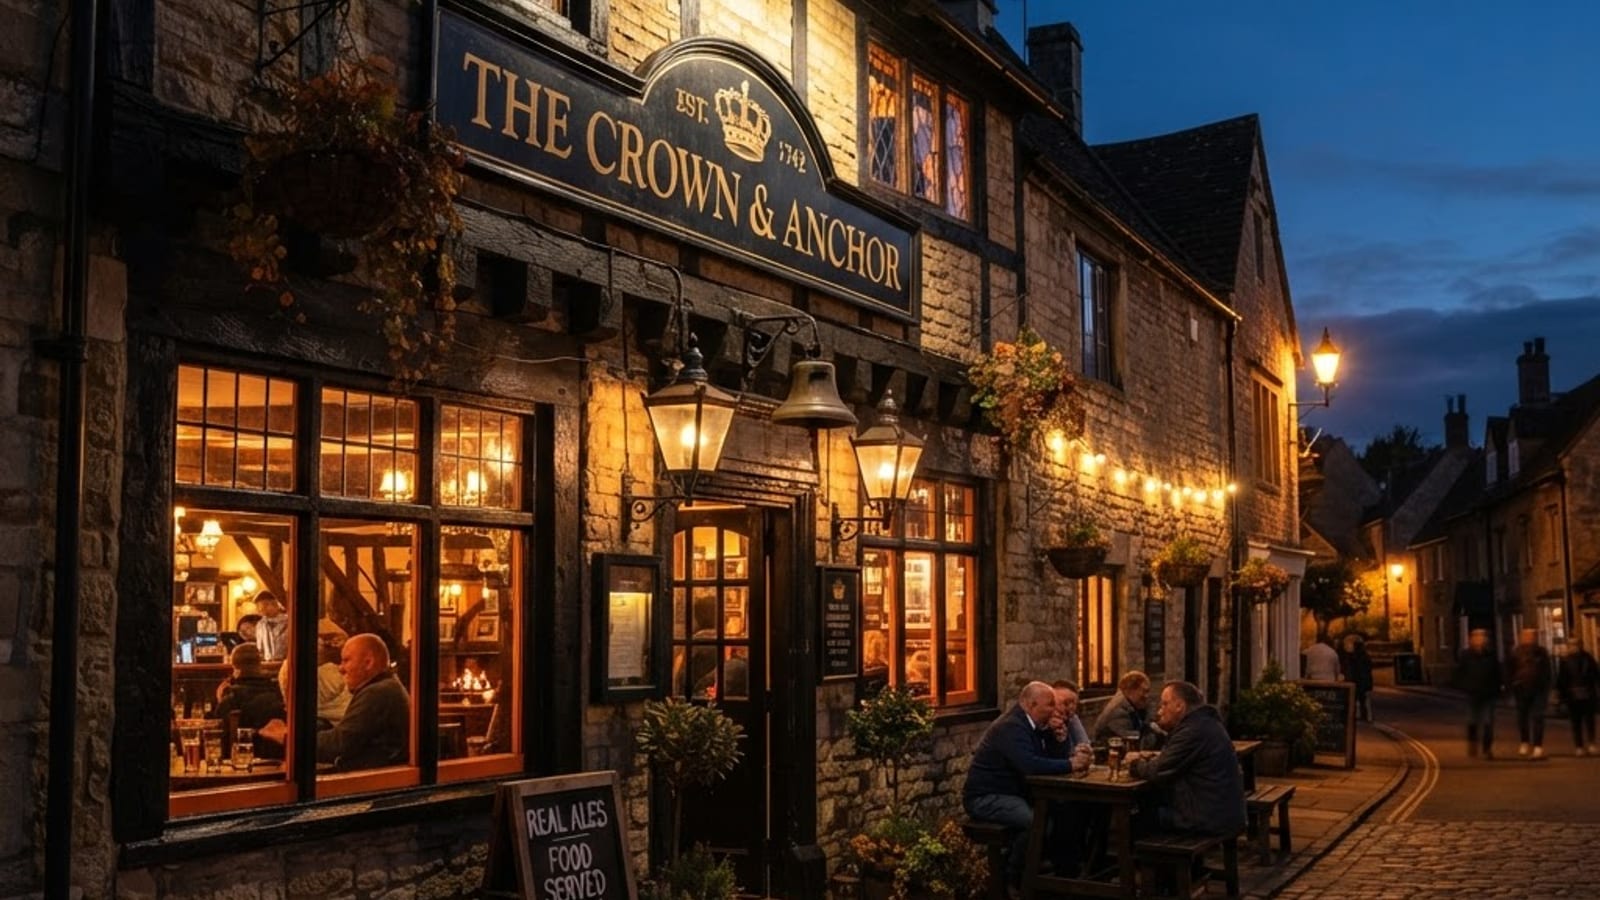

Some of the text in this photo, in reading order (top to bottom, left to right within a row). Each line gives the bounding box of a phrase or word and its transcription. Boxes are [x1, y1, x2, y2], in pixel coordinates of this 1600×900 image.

[675, 87, 709, 125] EST.
[462, 51, 902, 291] THE CROWN & ANCHOR
[526, 800, 608, 839] REAL ALES
[549, 842, 593, 873] FOOD
[544, 869, 606, 900] SERVED
